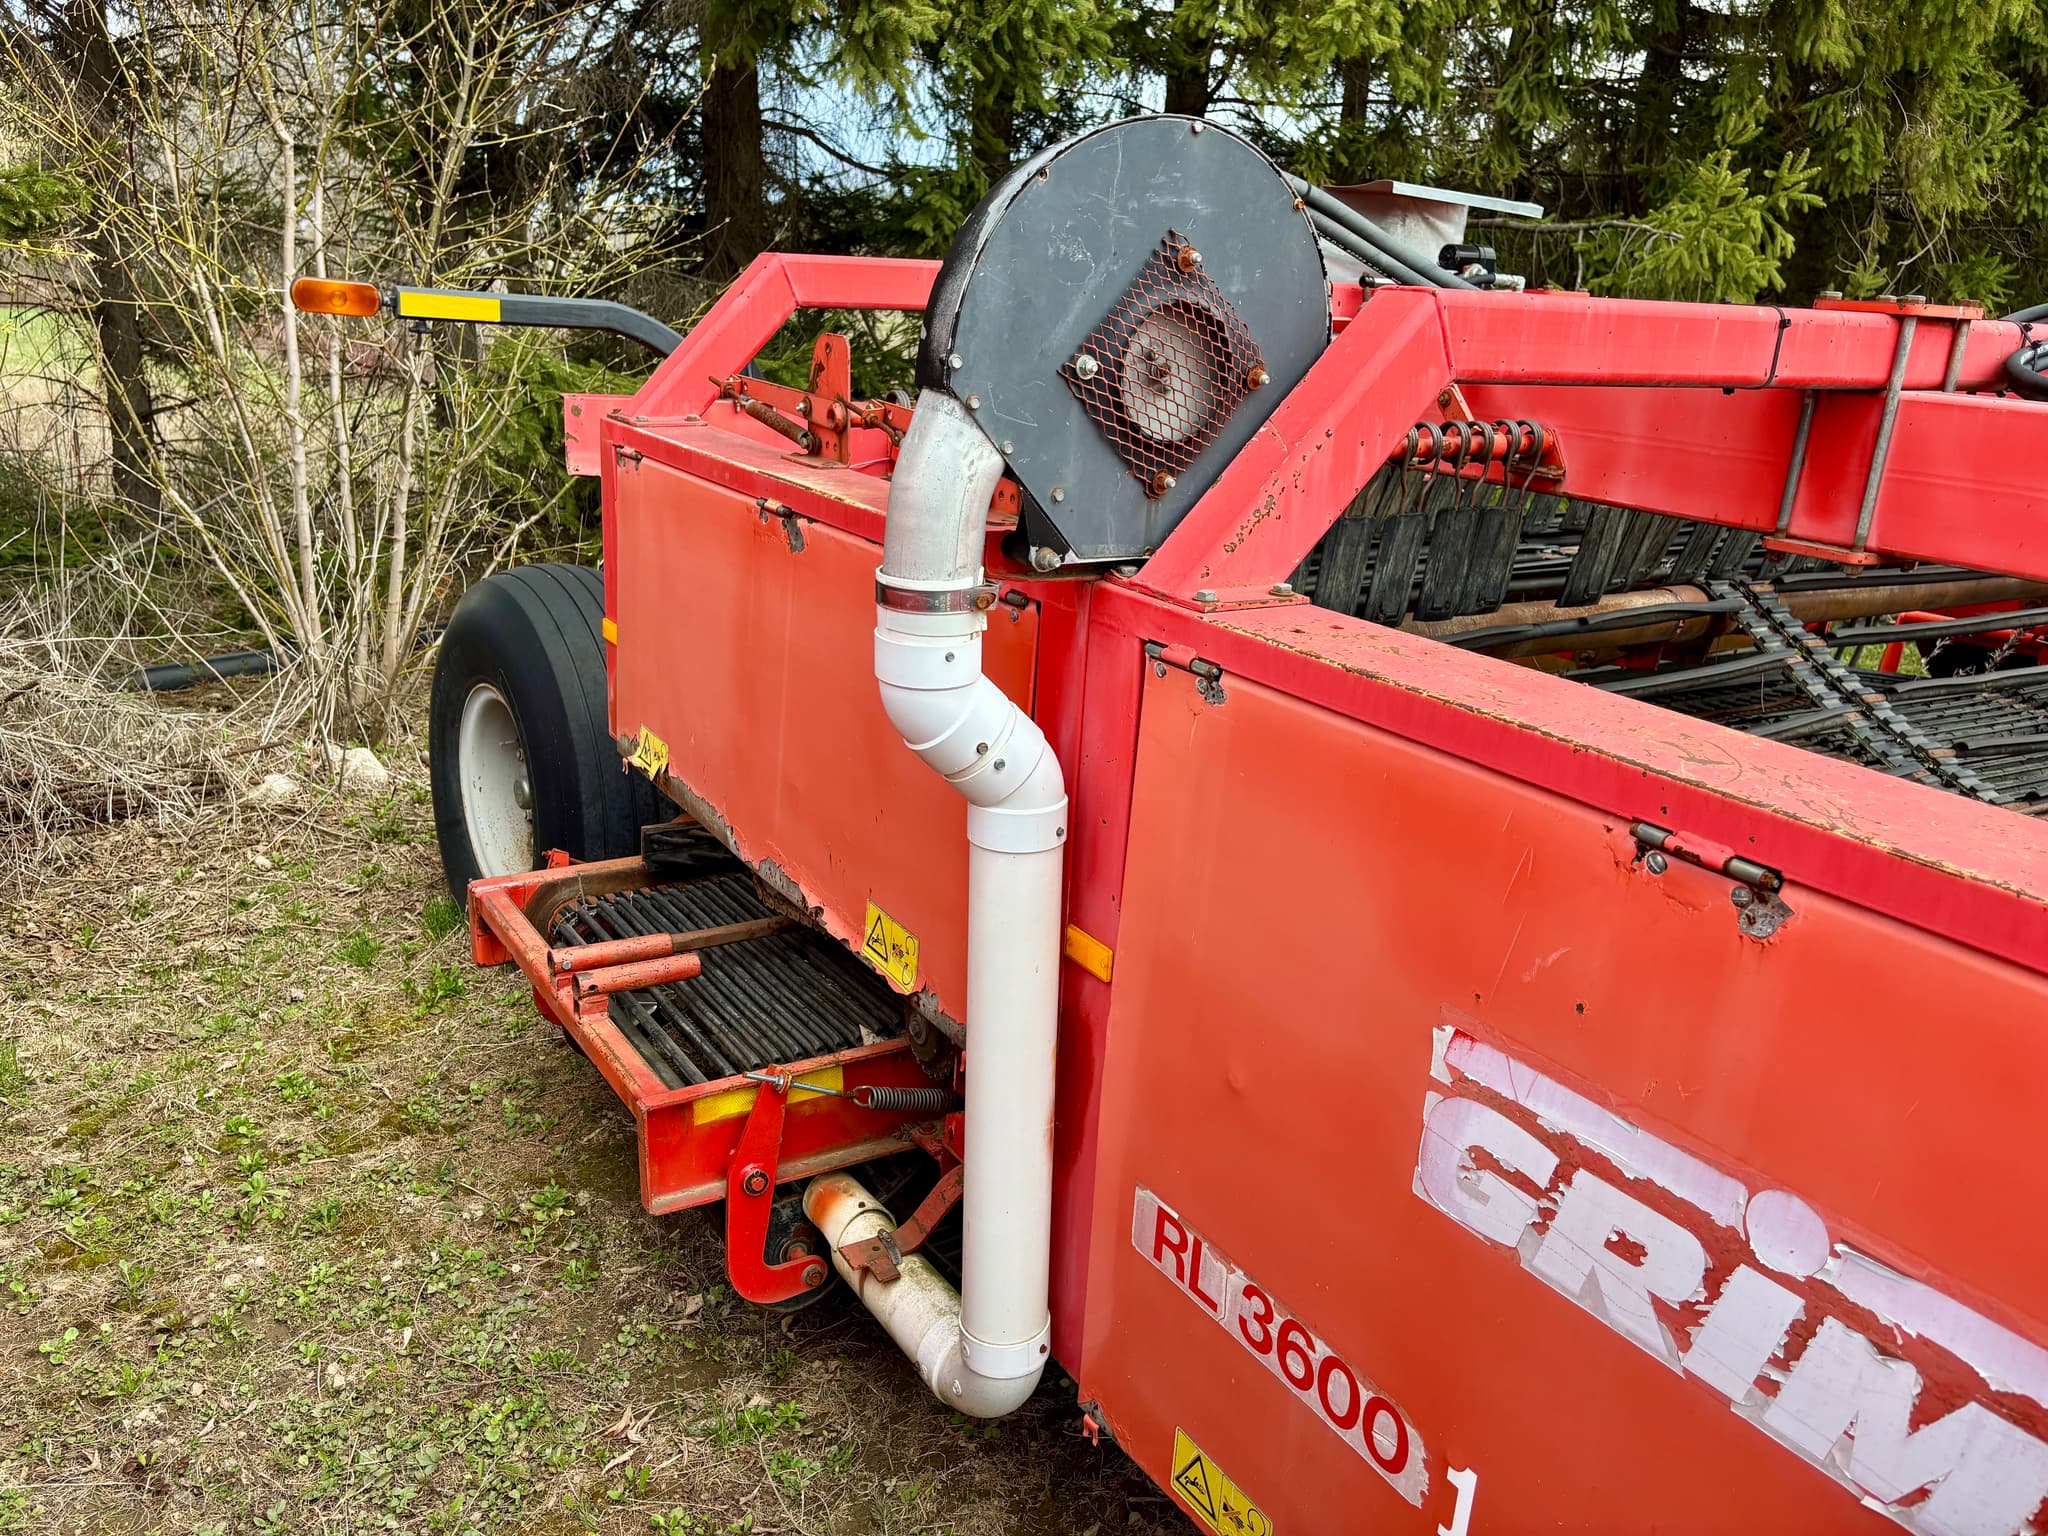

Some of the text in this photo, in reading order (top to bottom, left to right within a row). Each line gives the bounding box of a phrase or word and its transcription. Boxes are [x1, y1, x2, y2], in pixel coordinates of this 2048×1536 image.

[1153, 1205, 1409, 1475] RL 3600
[1437, 1465, 1478, 1536] 1
